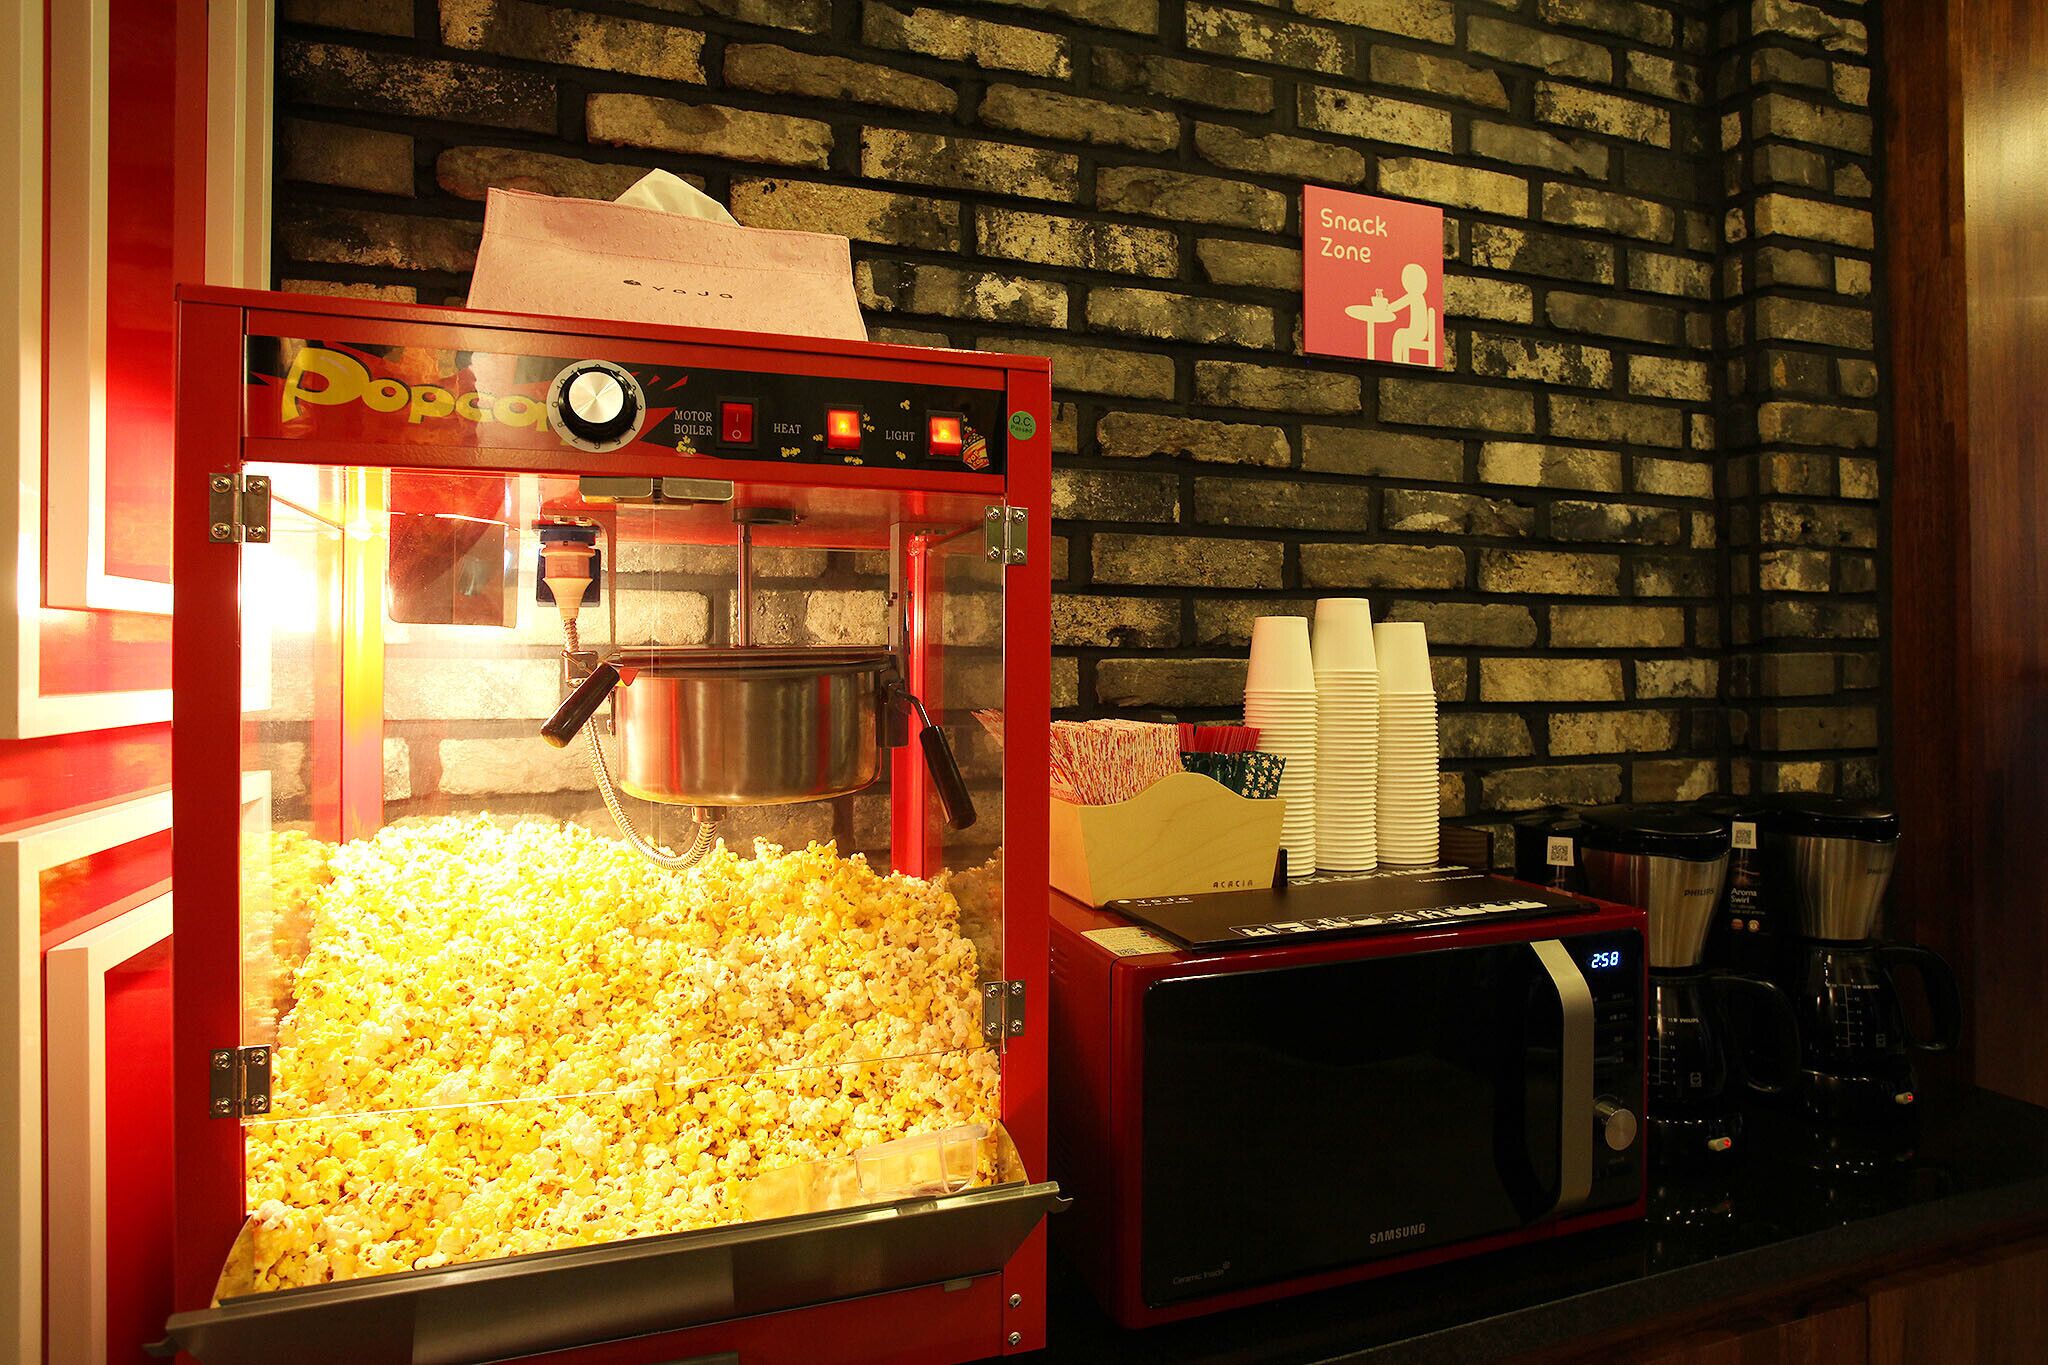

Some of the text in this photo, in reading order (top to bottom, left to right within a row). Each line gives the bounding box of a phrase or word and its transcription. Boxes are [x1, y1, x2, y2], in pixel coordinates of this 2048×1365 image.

[1320, 208, 1388, 237] Snack
[1320, 236, 1371, 263] Zone
[674, 410, 713, 422] MOTOR
[673, 423, 713, 436] BOILER
[773, 423, 802, 434] HEAT
[885, 430, 916, 442] LIGHT
[1730, 888, 1758, 897] Aroma
[1730, 895, 1750, 904] Swirl
[1591, 951, 1620, 969] 2:58
[1369, 1222, 1426, 1245] SAMSUNG
